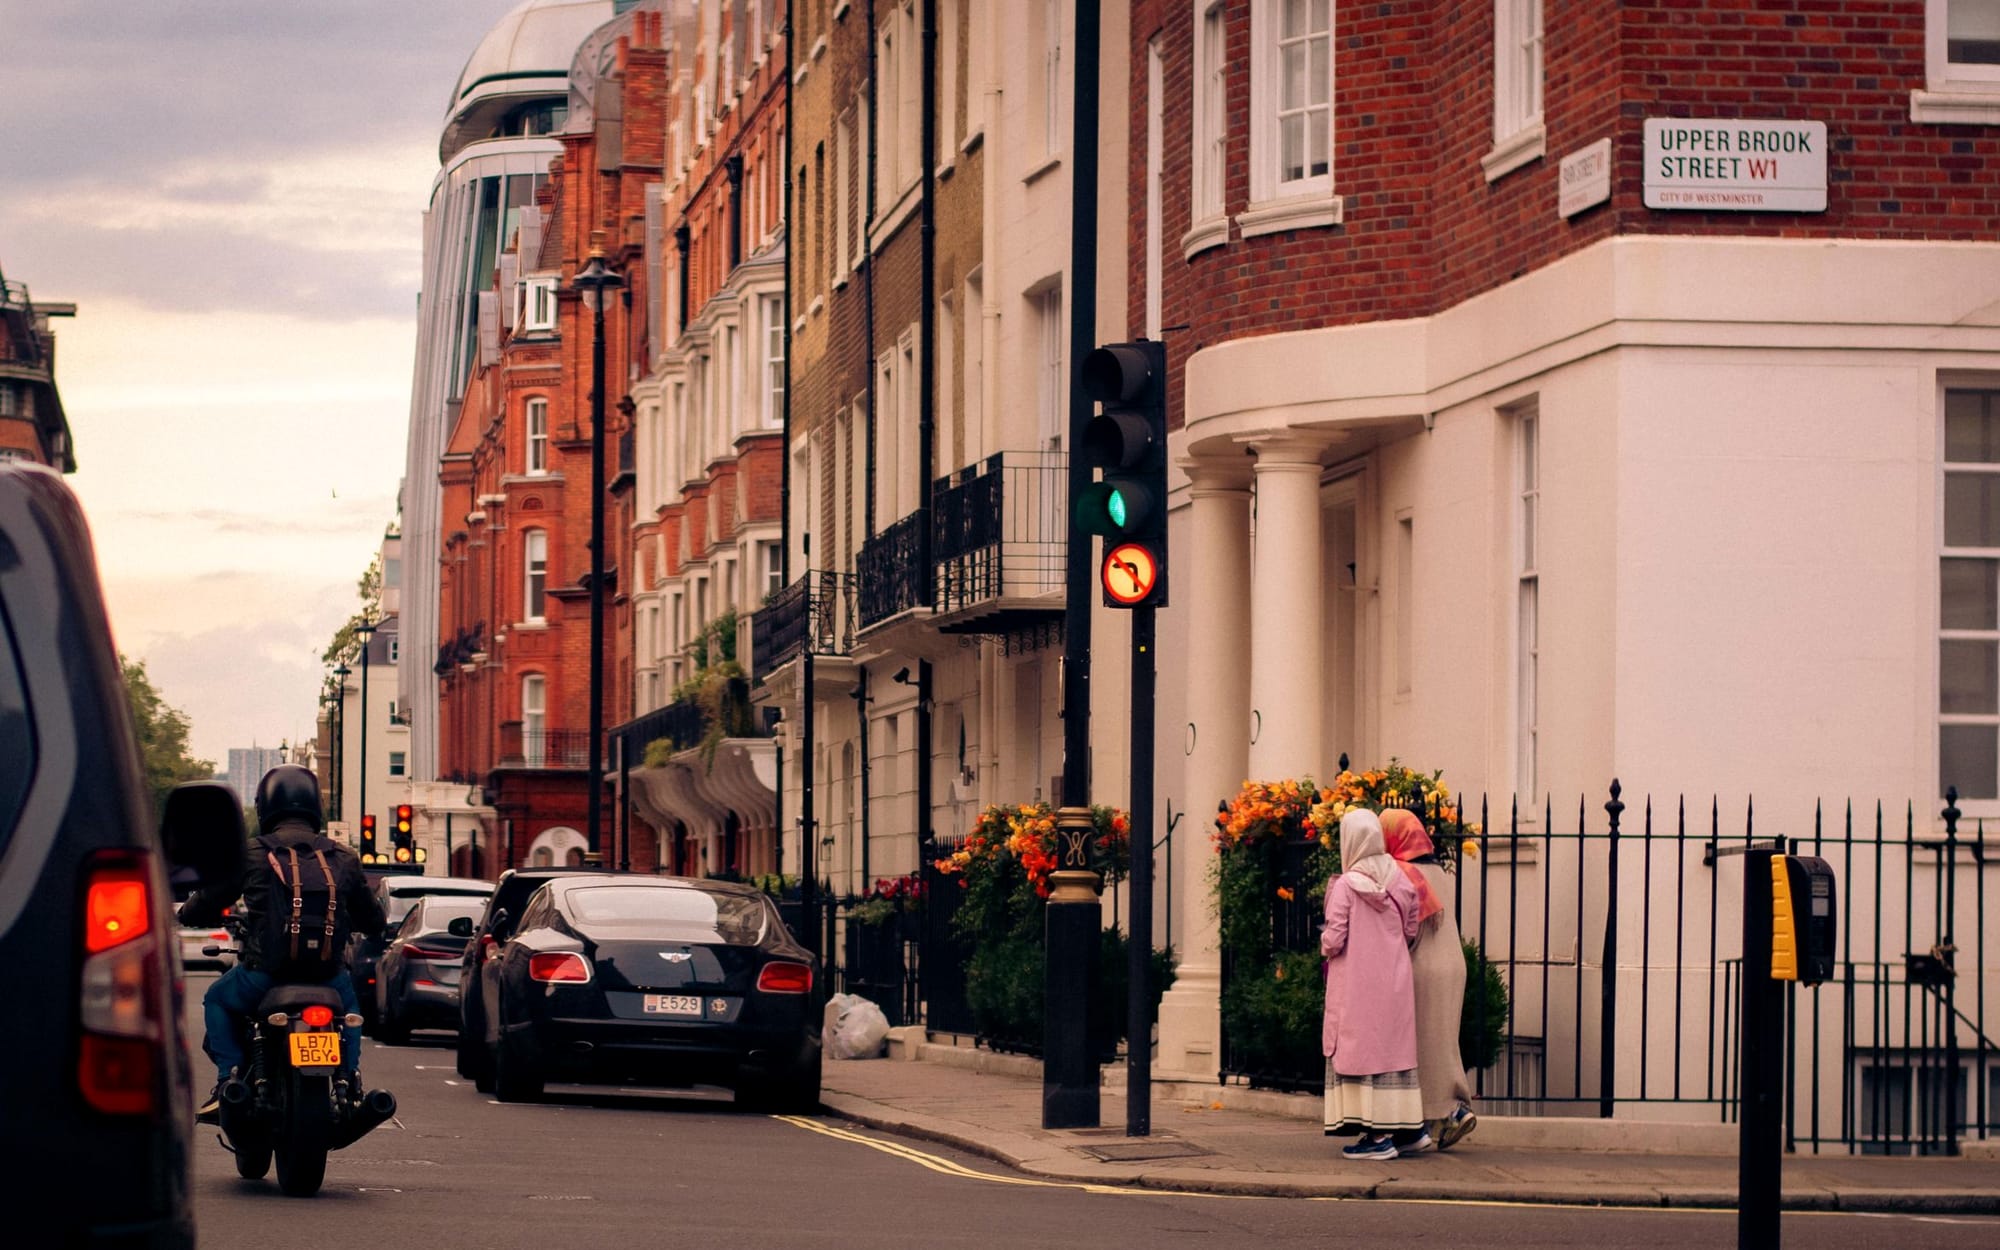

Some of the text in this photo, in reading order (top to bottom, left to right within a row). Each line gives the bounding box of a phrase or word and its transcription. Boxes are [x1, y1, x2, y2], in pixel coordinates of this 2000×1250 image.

[1660, 129, 1812, 153] UPPER BROOK
[1660, 156, 1778, 180] STREET W1
[1660, 192, 1764, 204] CITY OF WESTMINSTER
[660, 996, 698, 1010] E529
[297, 1035, 333, 1048] LB71
[300, 1049, 332, 1062] BGY
